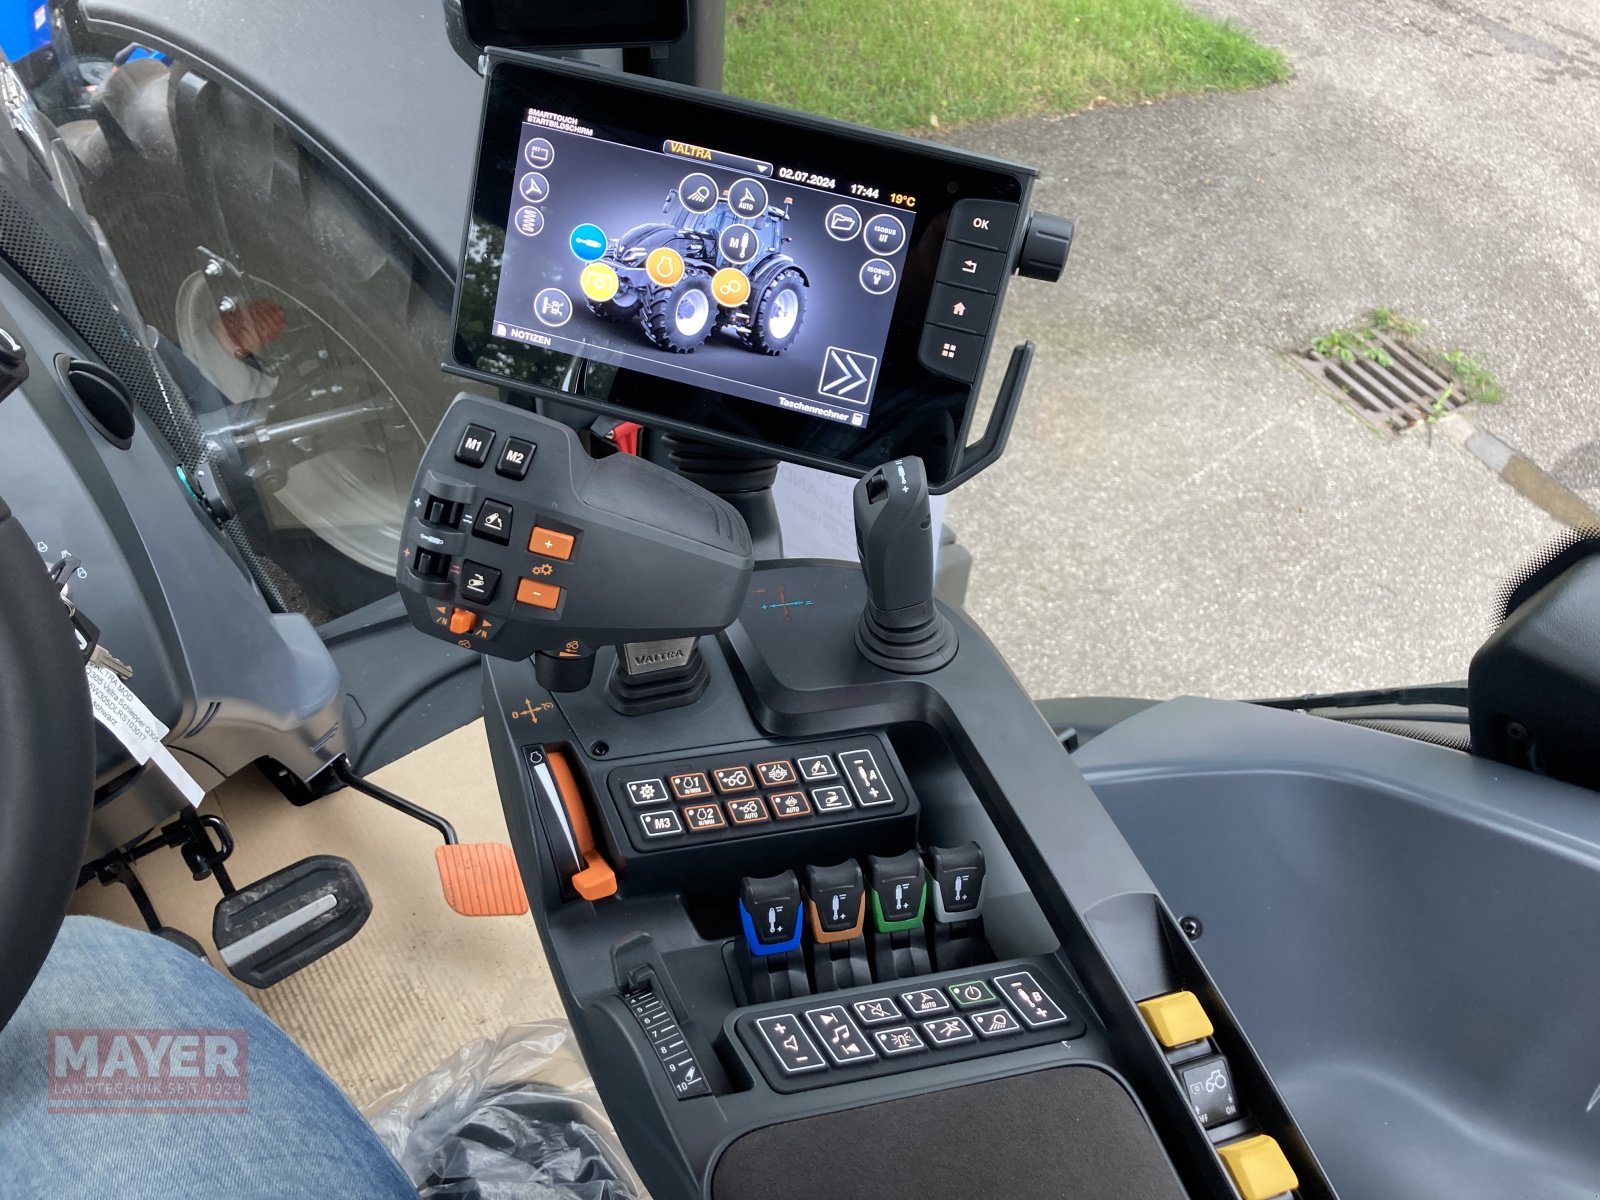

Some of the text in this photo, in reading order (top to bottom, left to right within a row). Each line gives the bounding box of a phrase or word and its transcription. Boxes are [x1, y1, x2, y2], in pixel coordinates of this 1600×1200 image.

[527, 107, 579, 125] SMARTTOUCH
[527, 115, 594, 136] STARTBILDSCHIRM
[670, 141, 712, 161] VALTRA
[779, 167, 916, 207] 02.07.2024 17:44 19°C
[738, 201, 754, 211] AUTO
[972, 217, 989, 231] OK
[874, 225, 897, 236] ISOBUS
[878, 233, 889, 243] UT
[867, 265, 891, 277] ISOBUS
[510, 327, 552, 346] NOTIZEN
[778, 396, 850, 423] Taschenrechner
[464, 436, 482, 452] M1
[506, 449, 525, 464] M2
[634, 649, 684, 666] VALTRA
[117, 684, 133, 701] MOD
[103, 681, 119, 701] Valtra
[119, 698, 145, 728] Schlepper
[869, 769, 878, 781] A
[744, 811, 759, 820] AUTO
[786, 806, 800, 814] AUTO
[654, 817, 671, 830] M3
[1031, 991, 1043, 1002] B
[921, 1000, 937, 1010] AUTO
[652, 1030, 658, 1038] 7
[660, 1046, 668, 1054] 8
[669, 1063, 676, 1072] 9
[677, 1081, 688, 1092] 10
[1225, 1105, 1236, 1115] ON
